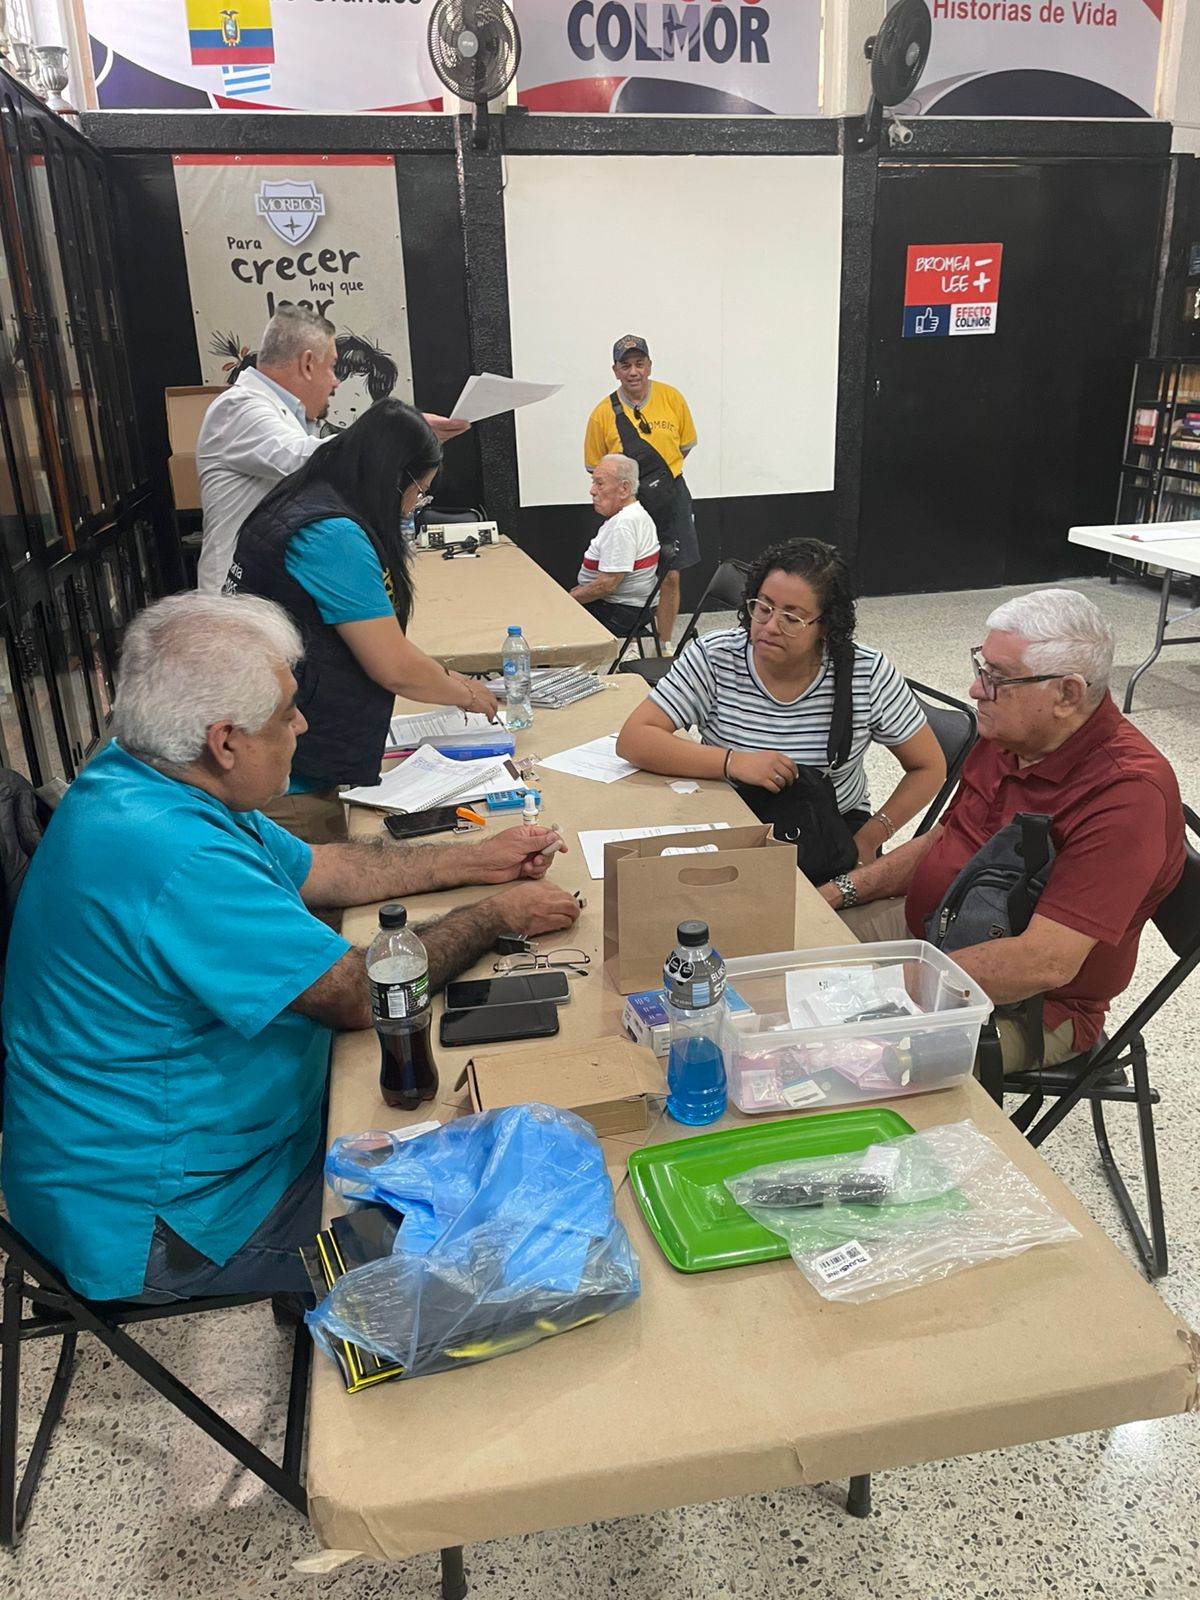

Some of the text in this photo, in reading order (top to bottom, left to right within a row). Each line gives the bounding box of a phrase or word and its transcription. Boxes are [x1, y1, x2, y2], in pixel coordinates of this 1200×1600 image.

[933, 0, 1117, 26] Historias de Vida
[567, 0, 771, 64] COLMOR
[259, 198, 321, 211] MORELOS
[227, 236, 262, 250] Para
[231, 248, 361, 285] crecer
[915, 255, 970, 272] BROMEA
[309, 279, 364, 297] hay que
[941, 274, 969, 293] LEE
[266, 291, 336, 320] lr
[956, 306, 992, 318] EFECTO
[955, 317, 991, 328] COLMOR
